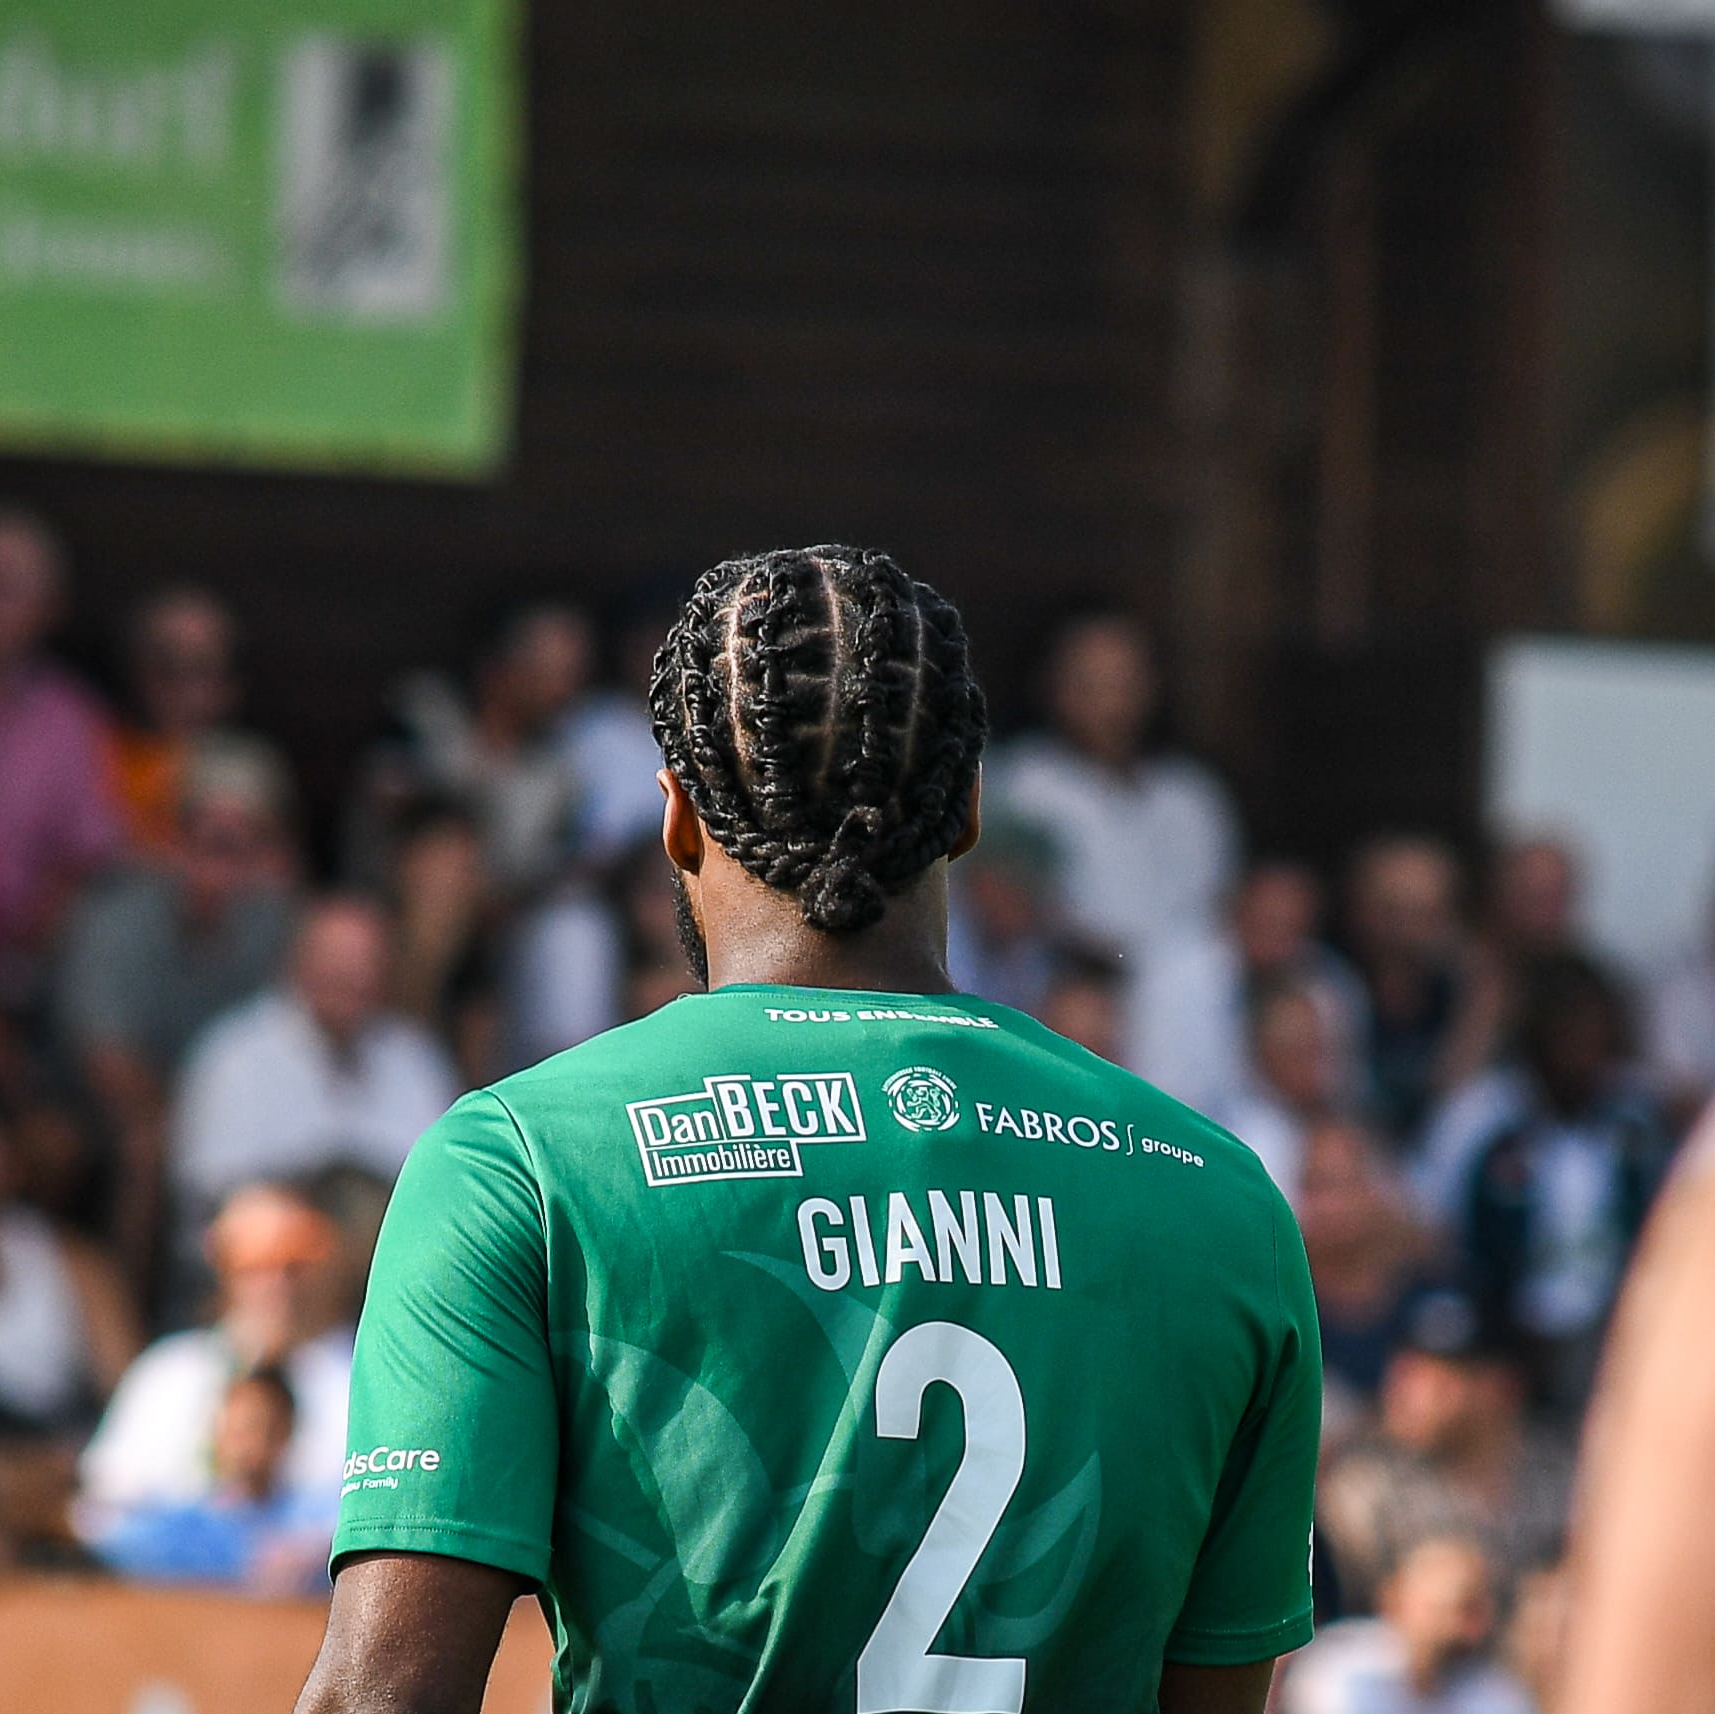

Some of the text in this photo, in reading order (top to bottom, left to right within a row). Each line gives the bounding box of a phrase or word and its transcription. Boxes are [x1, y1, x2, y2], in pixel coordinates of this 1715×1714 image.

[764, 1009, 851, 1022] TOUS
[717, 1080, 857, 1138] BECK
[975, 1102, 1204, 1167] FABROS groupe
[653, 1143, 791, 1177] Immobilière
[797, 1189, 1062, 1292] GIANNI
[363, 1476, 399, 1489] Family
